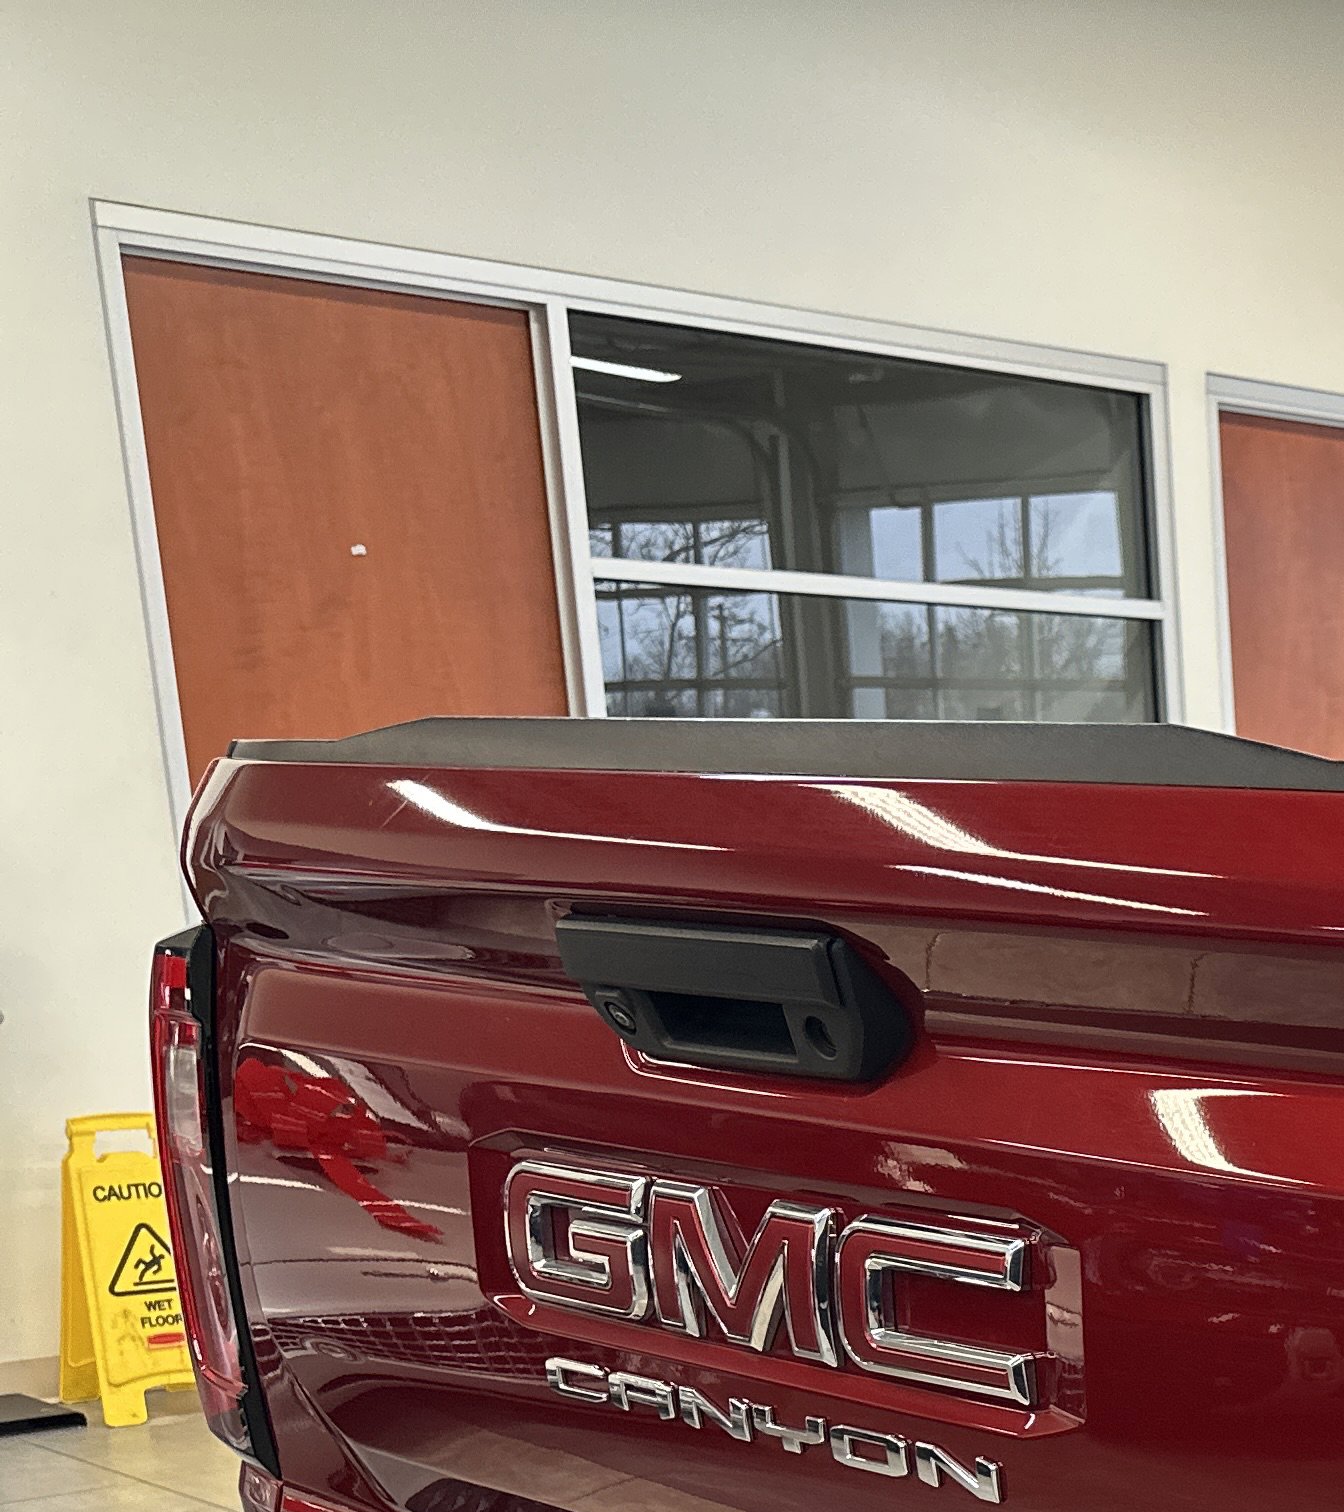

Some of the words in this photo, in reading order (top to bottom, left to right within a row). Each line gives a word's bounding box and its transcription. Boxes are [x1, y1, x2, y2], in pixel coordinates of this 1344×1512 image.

[92, 1182, 162, 1203] CAUTIO
[144, 1298, 174, 1312] WET
[503, 1158, 1032, 1407] GMC
[545, 1357, 1002, 1504] CANYON
